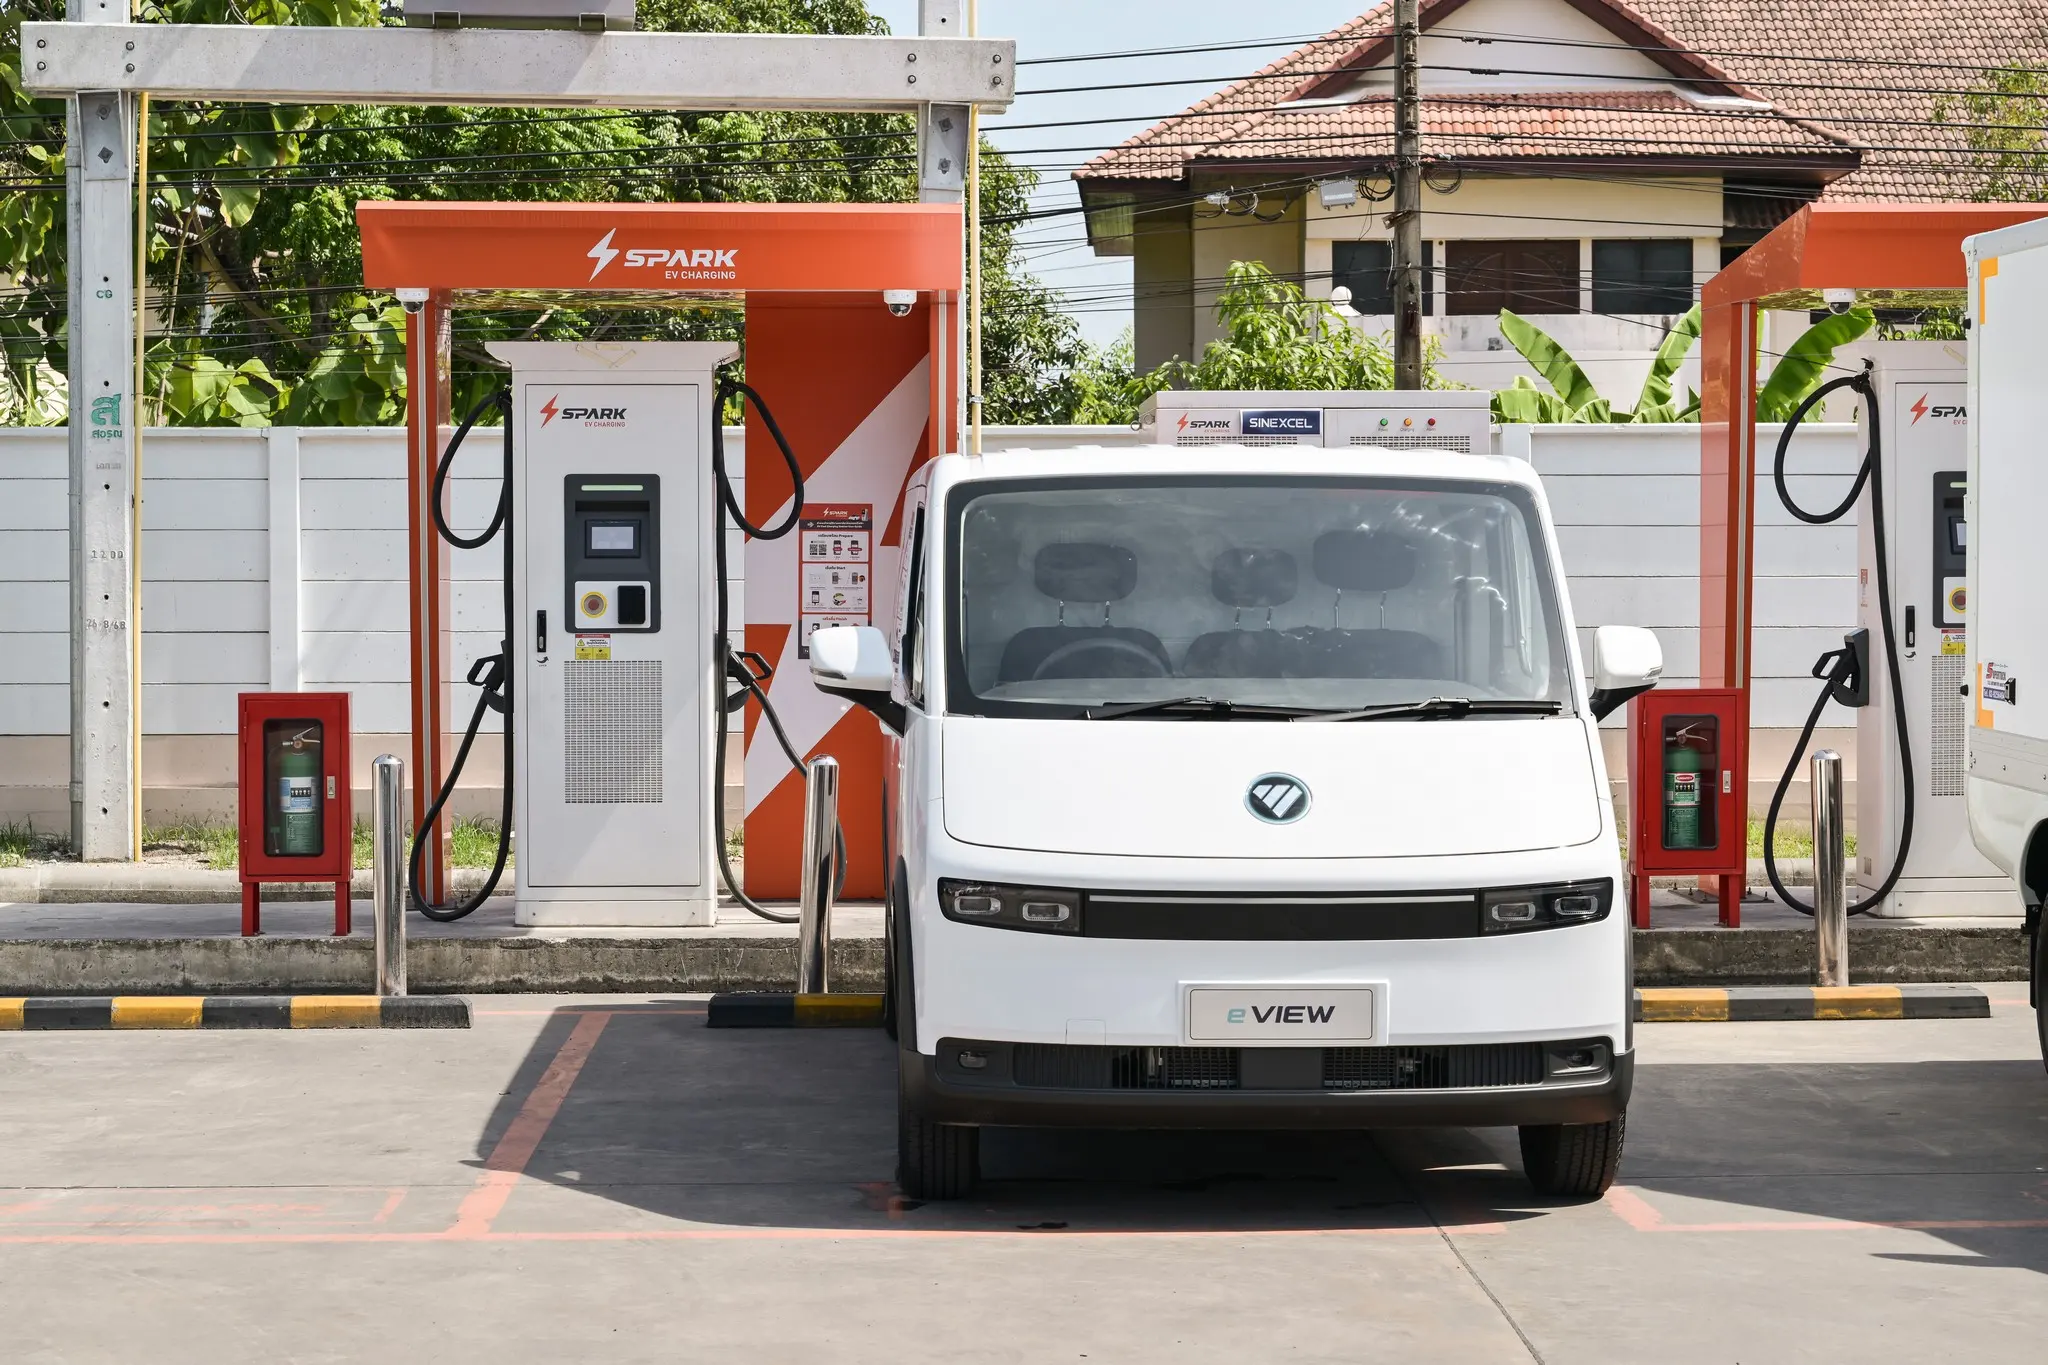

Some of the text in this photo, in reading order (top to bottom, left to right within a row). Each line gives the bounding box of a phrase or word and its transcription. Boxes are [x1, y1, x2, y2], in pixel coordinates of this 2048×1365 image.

[624, 249, 739, 267] SPARK
[665, 270, 736, 280] EV CHARGING
[562, 408, 627, 420] SPARK
[1931, 406, 1967, 418] SPA
[1190, 420, 1231, 428] SPARK
[1249, 417, 1313, 429] SINEXCEL
[1227, 1006, 1336, 1024] e VIEW
